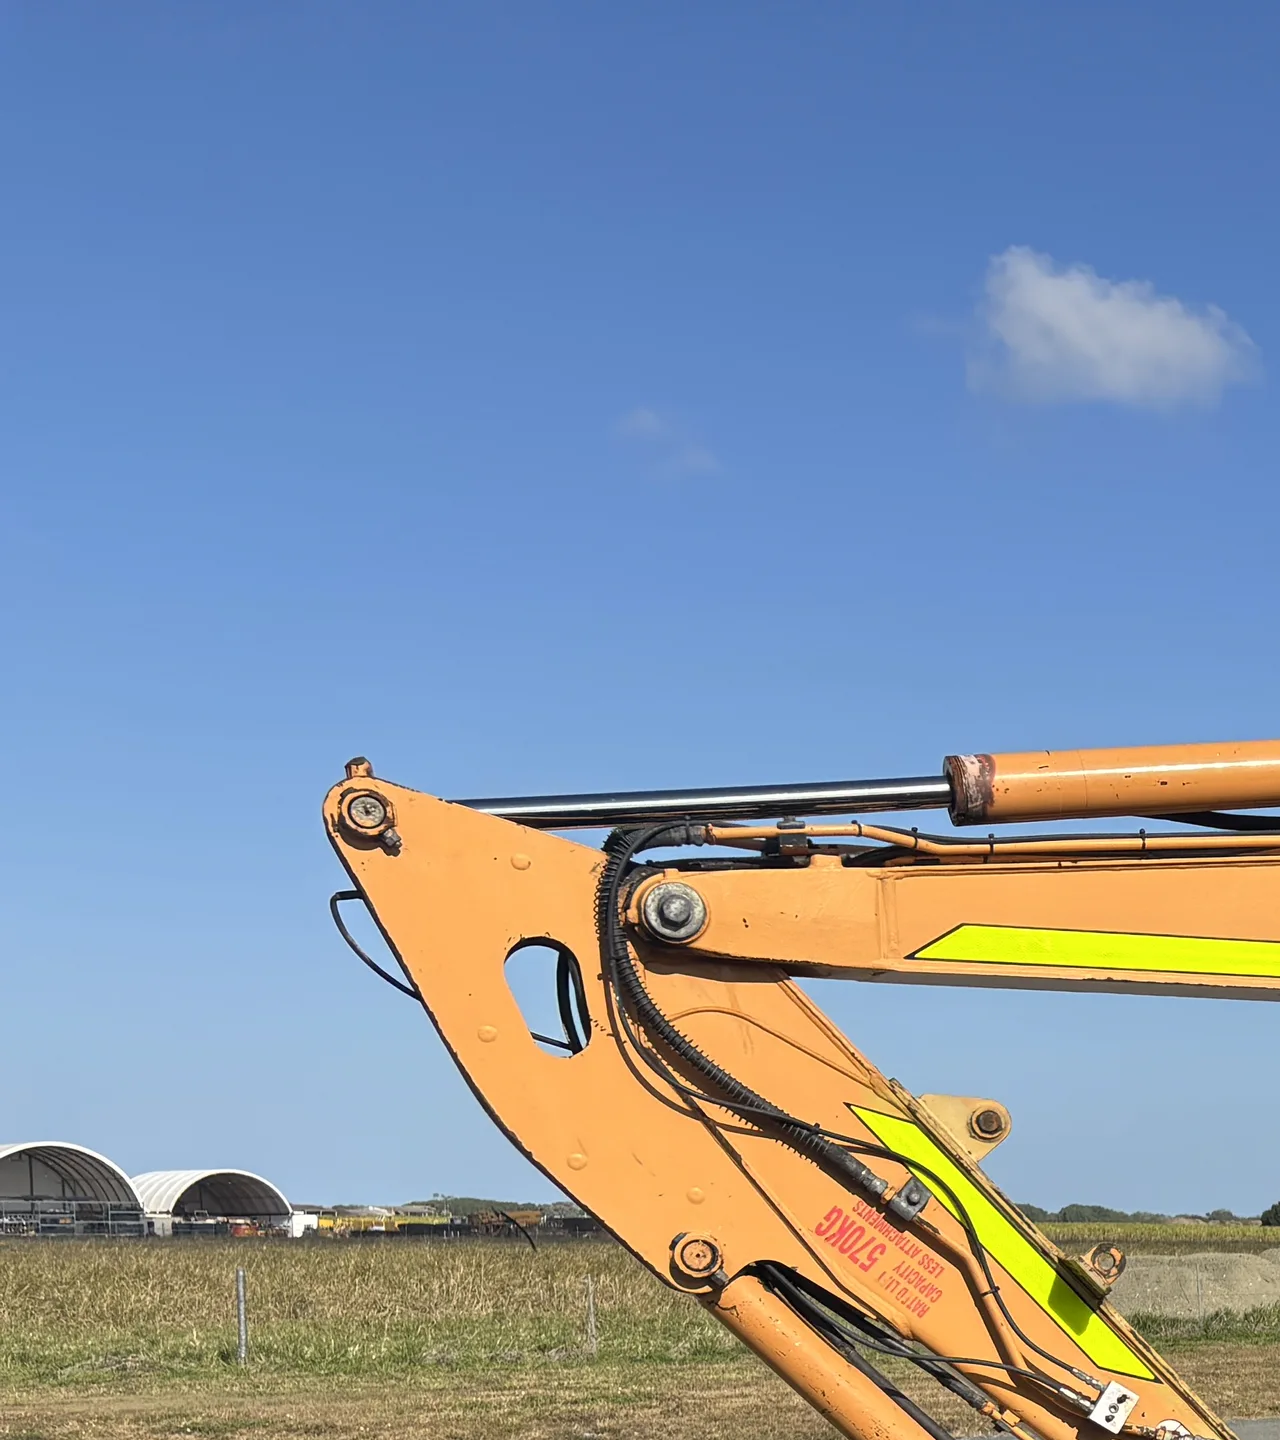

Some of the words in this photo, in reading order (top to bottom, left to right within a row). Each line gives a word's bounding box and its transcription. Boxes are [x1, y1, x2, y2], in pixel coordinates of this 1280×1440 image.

[815, 1205, 887, 1272] 570KG
[852, 1200, 923, 1259] ATTACHMENTS
[877, 1270, 900, 1294] LIT
[892, 1260, 943, 1303] CAPACITY
[916, 1253, 945, 1279] LESS
